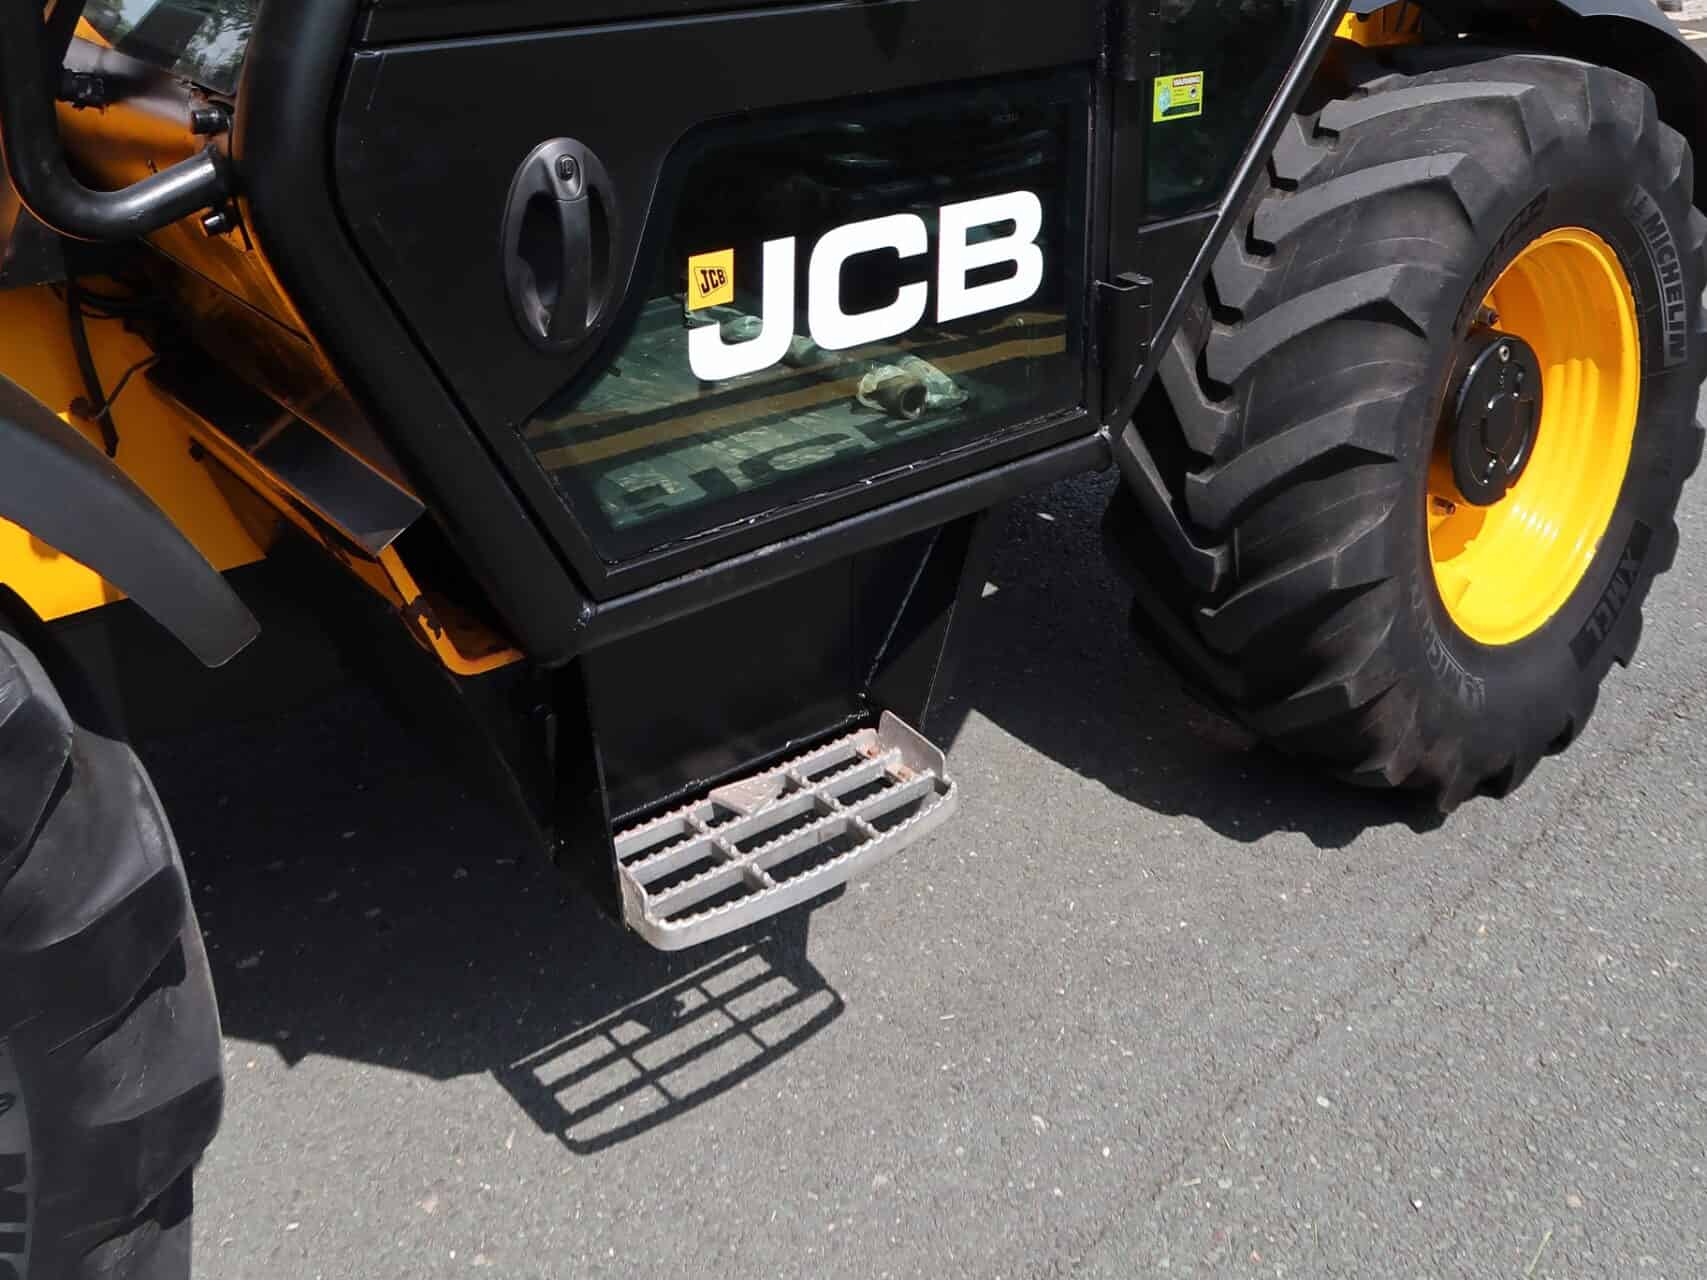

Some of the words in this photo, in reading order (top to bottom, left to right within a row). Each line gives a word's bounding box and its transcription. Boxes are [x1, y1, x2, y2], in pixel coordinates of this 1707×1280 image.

[688, 190, 1043, 381] JCB
[700, 269, 726, 294] JCB
[1643, 211, 1686, 359] MICHELIN
